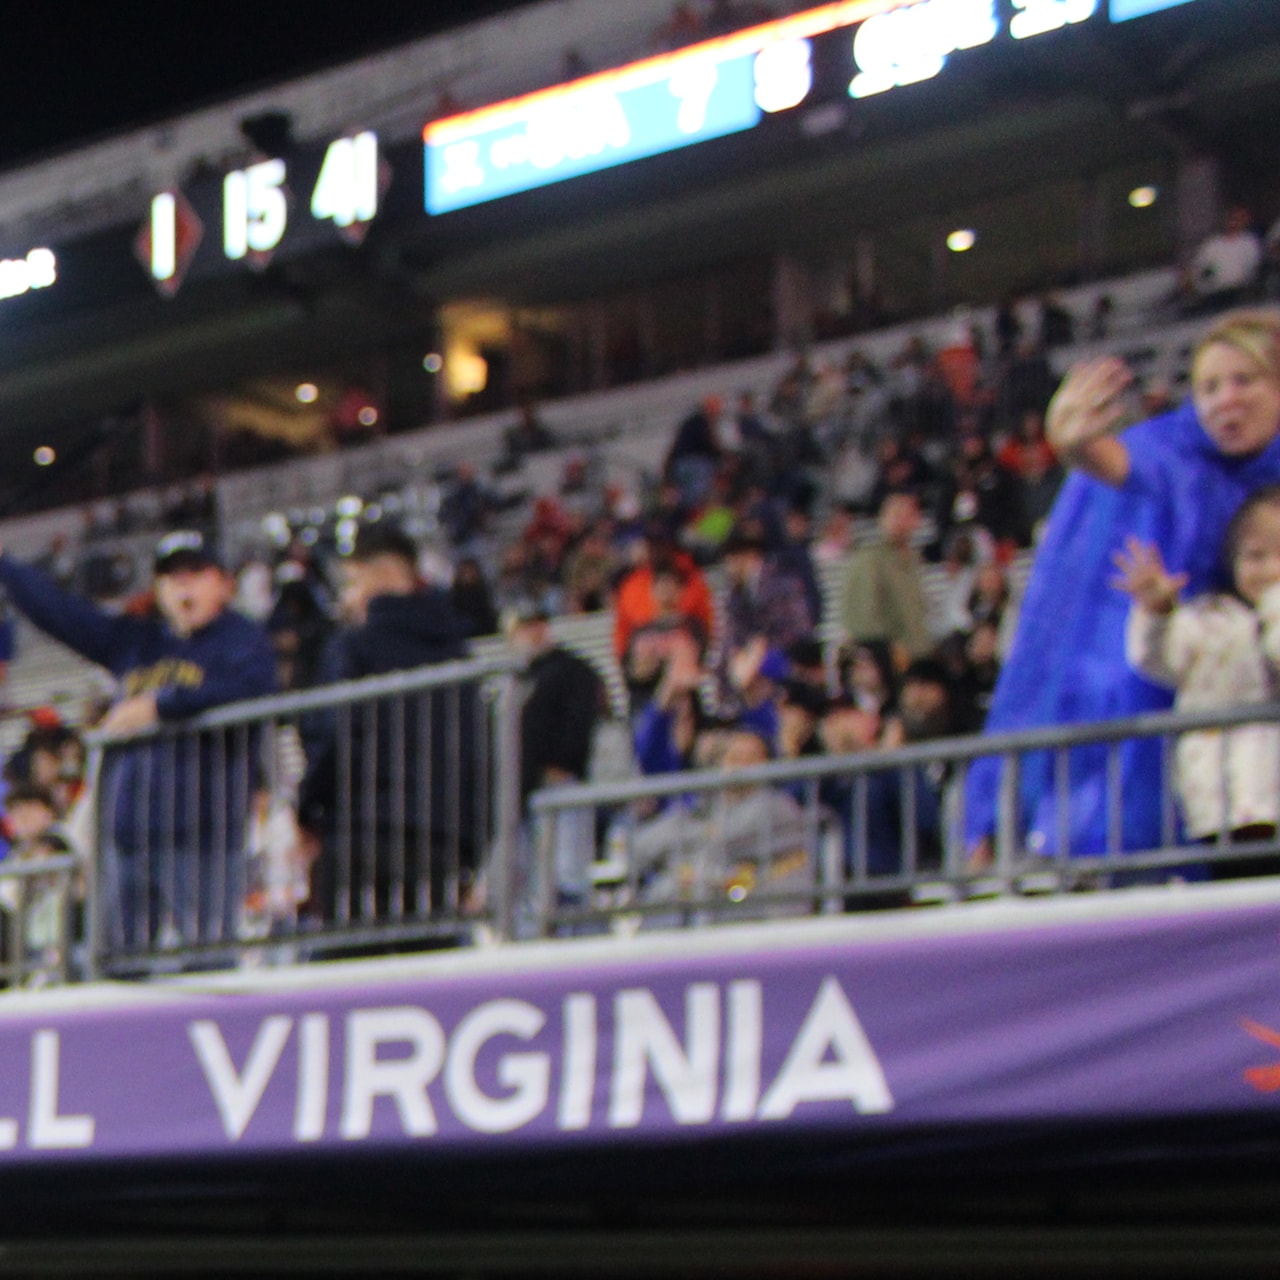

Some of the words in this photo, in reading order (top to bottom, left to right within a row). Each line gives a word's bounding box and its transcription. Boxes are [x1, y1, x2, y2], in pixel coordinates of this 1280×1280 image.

[222, 156, 288, 261] 15
[309, 130, 378, 227] 41
[187, 975, 896, 1142] VIRGINIA
